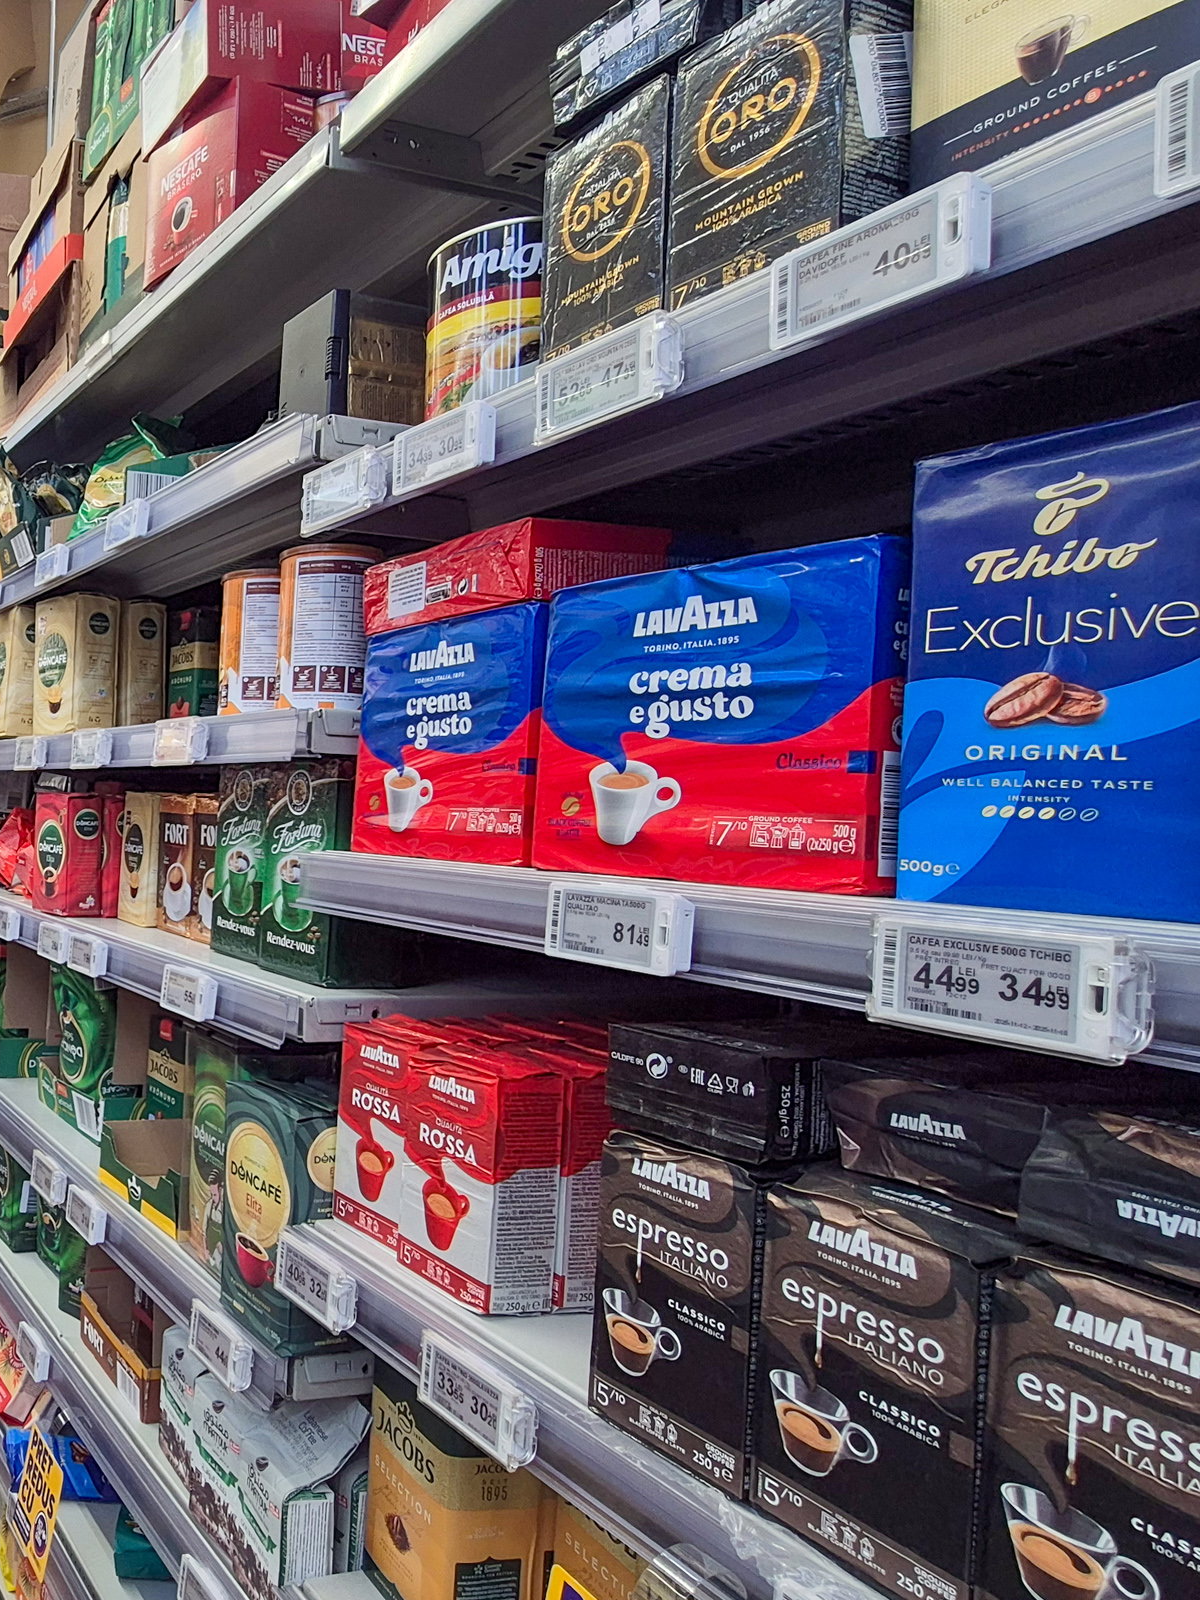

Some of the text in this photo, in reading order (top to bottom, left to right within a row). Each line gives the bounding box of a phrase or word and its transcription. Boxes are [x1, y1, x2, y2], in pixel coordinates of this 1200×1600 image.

[342, 32, 386, 57] NESC
[354, 54, 384, 66] BRAS
[709, 77, 798, 145] ORO
[972, 60, 1119, 135] GROUND COFFEE
[729, 126, 772, 154] DAL 1956
[951, 130, 1010, 162] INTENSITY
[166, 168, 204, 201] BRASERO
[571, 177, 634, 234] ORO
[694, 171, 805, 232] MOUNTAIN GROWN
[739, 194, 783, 222] ARABICA
[796, 219, 832, 240] GROUND
[799, 227, 832, 243] COFFEE
[913, 233, 931, 247] LEI
[439, 237, 544, 293] Amig
[609, 255, 640, 280] GROWN
[799, 239, 854, 269] CAFEA FINE
[799, 252, 847, 280] DAVIDOFF
[965, 537, 1158, 585] Tchibo
[632, 594, 759, 638] LAVAZZA
[924, 592, 1200, 654] Exclusive
[717, 635, 740, 647] 1895
[171, 650, 194, 668] JACOBS
[409, 640, 475, 674] LAVAZZA
[628, 662, 753, 696] crema
[406, 688, 473, 717] crema
[629, 692, 755, 740] e gusto
[406, 713, 473, 750] e gusto
[775, 752, 843, 772] Classico
[965, 743, 1129, 762] ORIGINAL
[942, 777, 1155, 791] WELL BALANCED TASTE
[1007, 795, 1071, 804] INTENSITY
[164, 822, 189, 846] FORT
[220, 816, 262, 847] Fortuna
[716, 820, 748, 847] 7/10
[748, 815, 814, 824] GROUND COFFEE
[833, 824, 849, 838] 500
[270, 820, 323, 855] Fortuna
[567, 892, 595, 903] LAVAZZA
[266, 931, 316, 956] Rendez-vous
[909, 935, 941, 948] CAFEA
[943, 940, 999, 955] EXCLUSIVE
[1000, 946, 1027, 958] 500G
[958, 966, 976, 977] LEI
[149, 1056, 180, 1085] JACOBS
[359, 1044, 399, 1070] LAVAZZA
[428, 1073, 476, 1105] LAVAZZA
[351, 1087, 401, 1124] ROSSA
[889, 1112, 967, 1141] LAVAZZA
[418, 1121, 479, 1167] ROSSA
[631, 1157, 711, 1201] LAVAZZA
[245, 1191, 263, 1217] Elita
[684, 1198, 699, 1210] 1895
[612, 1208, 729, 1271] espresso
[807, 1220, 918, 1281] LAVAZZA
[659, 1250, 729, 1288] ITALIANO
[881, 1274, 902, 1290] 1895
[667, 1298, 726, 1332] CLASSICO
[676, 1313, 726, 1342] 100% ARABICA
[781, 1277, 945, 1365] espresso
[83, 1314, 104, 1357] FORT
[848, 1331, 944, 1387] ITALIANO
[597, 1381, 626, 1407] 5/10
[1162, 1376, 1193, 1395] 1895
[303, 1409, 329, 1443] Lebanese
[858, 1389, 942, 1438] CLASSICO
[871, 1408, 941, 1449] 100% ARABICA
[31, 1429, 54, 1473] PRET
[376, 1406, 436, 1485] JACOBS
[692, 1449, 712, 1471] 250
[704, 1442, 736, 1465] GROUND
[706, 1449, 736, 1471] COFFEE
[474, 1463, 508, 1477] JACO
[1115, 1444, 1200, 1496] ITALIA
[20, 1479, 35, 1514] CU
[25, 1453, 56, 1520] REDUS
[374, 1453, 433, 1526] SELECTION
[481, 1486, 508, 1502] 1895
[763, 1474, 803, 1508] 5/10
[1131, 1517, 1200, 1560] CLASS
[1151, 1542, 1184, 1565] 100%
[564, 1531, 633, 1600] SELECTI
[896, 1572, 924, 1598] 250
[913, 1566, 957, 1597] GROUND
